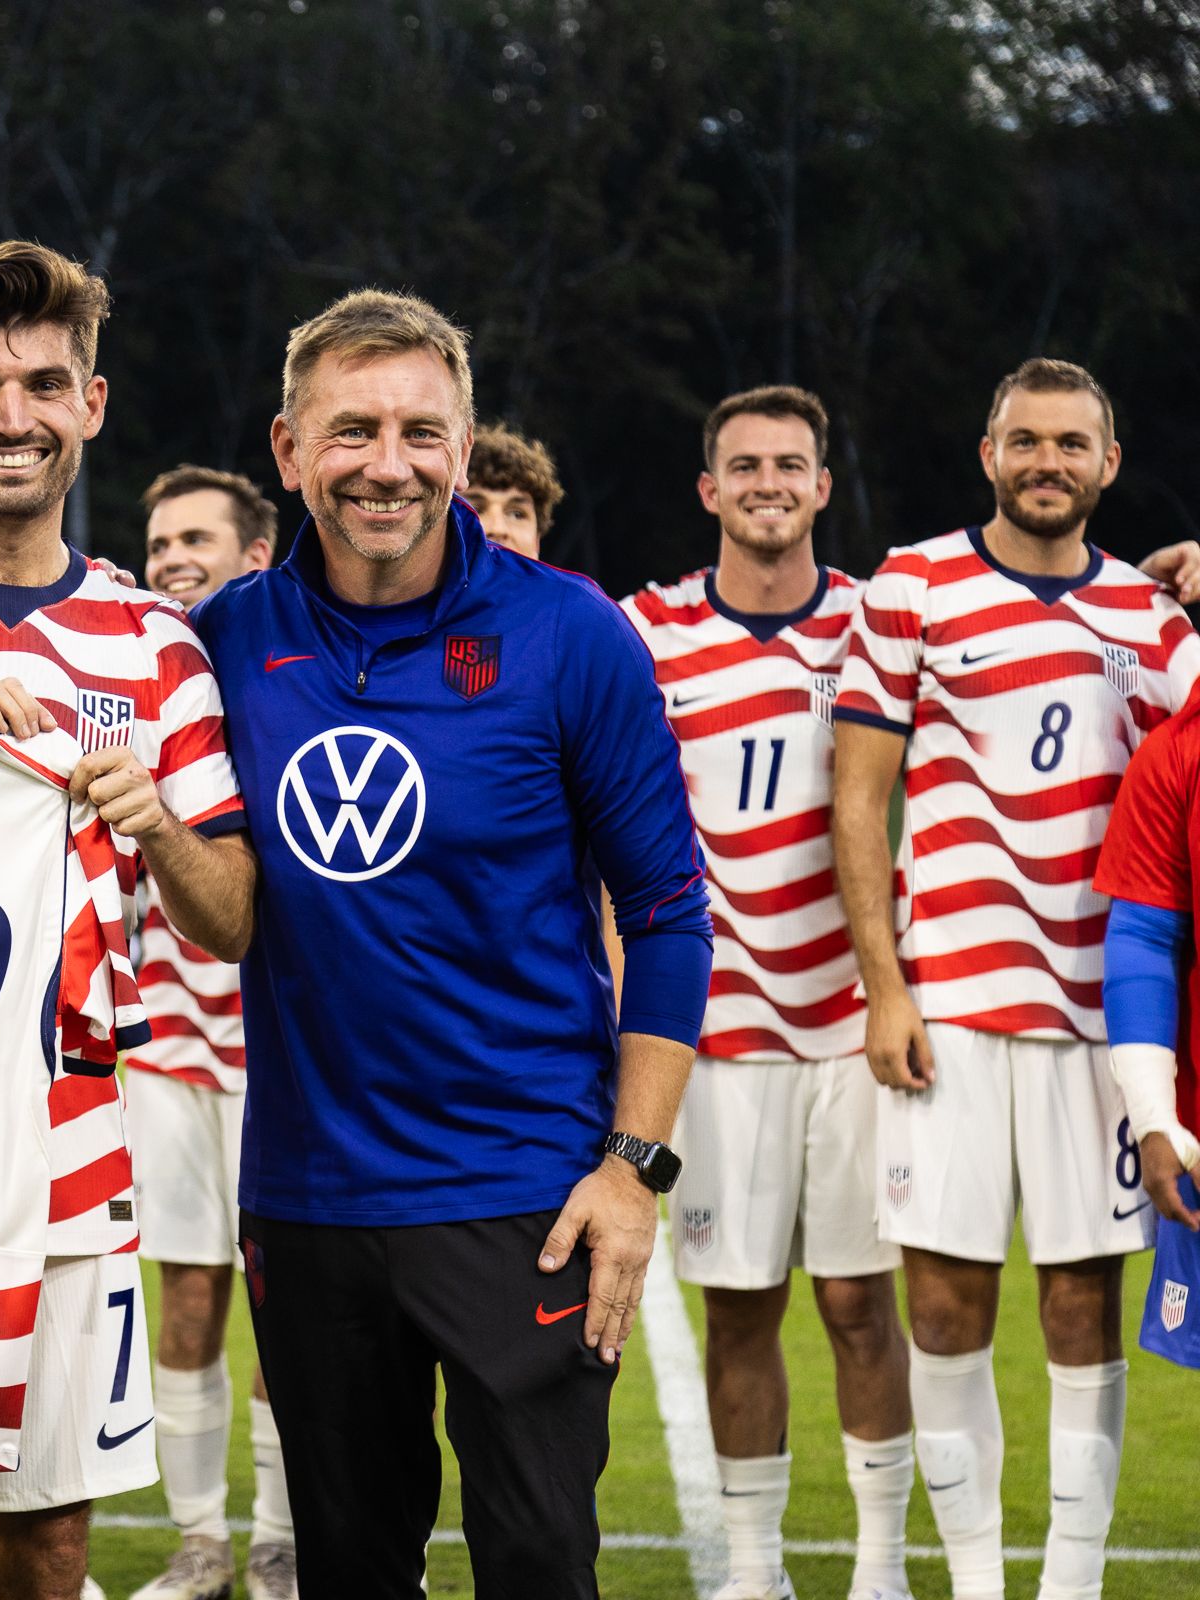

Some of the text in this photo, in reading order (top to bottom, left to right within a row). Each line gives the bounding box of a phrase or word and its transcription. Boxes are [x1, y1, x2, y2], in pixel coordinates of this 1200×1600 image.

[451, 641, 495, 664] USA
[1105, 646, 1137, 668] USA
[815, 678, 837, 698] US
[82, 694, 131, 727] USA
[1030, 701, 1072, 773] 8
[738, 738, 786, 811] 11
[1116, 1115, 1142, 1190] 8
[1166, 1284, 1186, 1303] USA
[108, 1287, 134, 1404] 7
